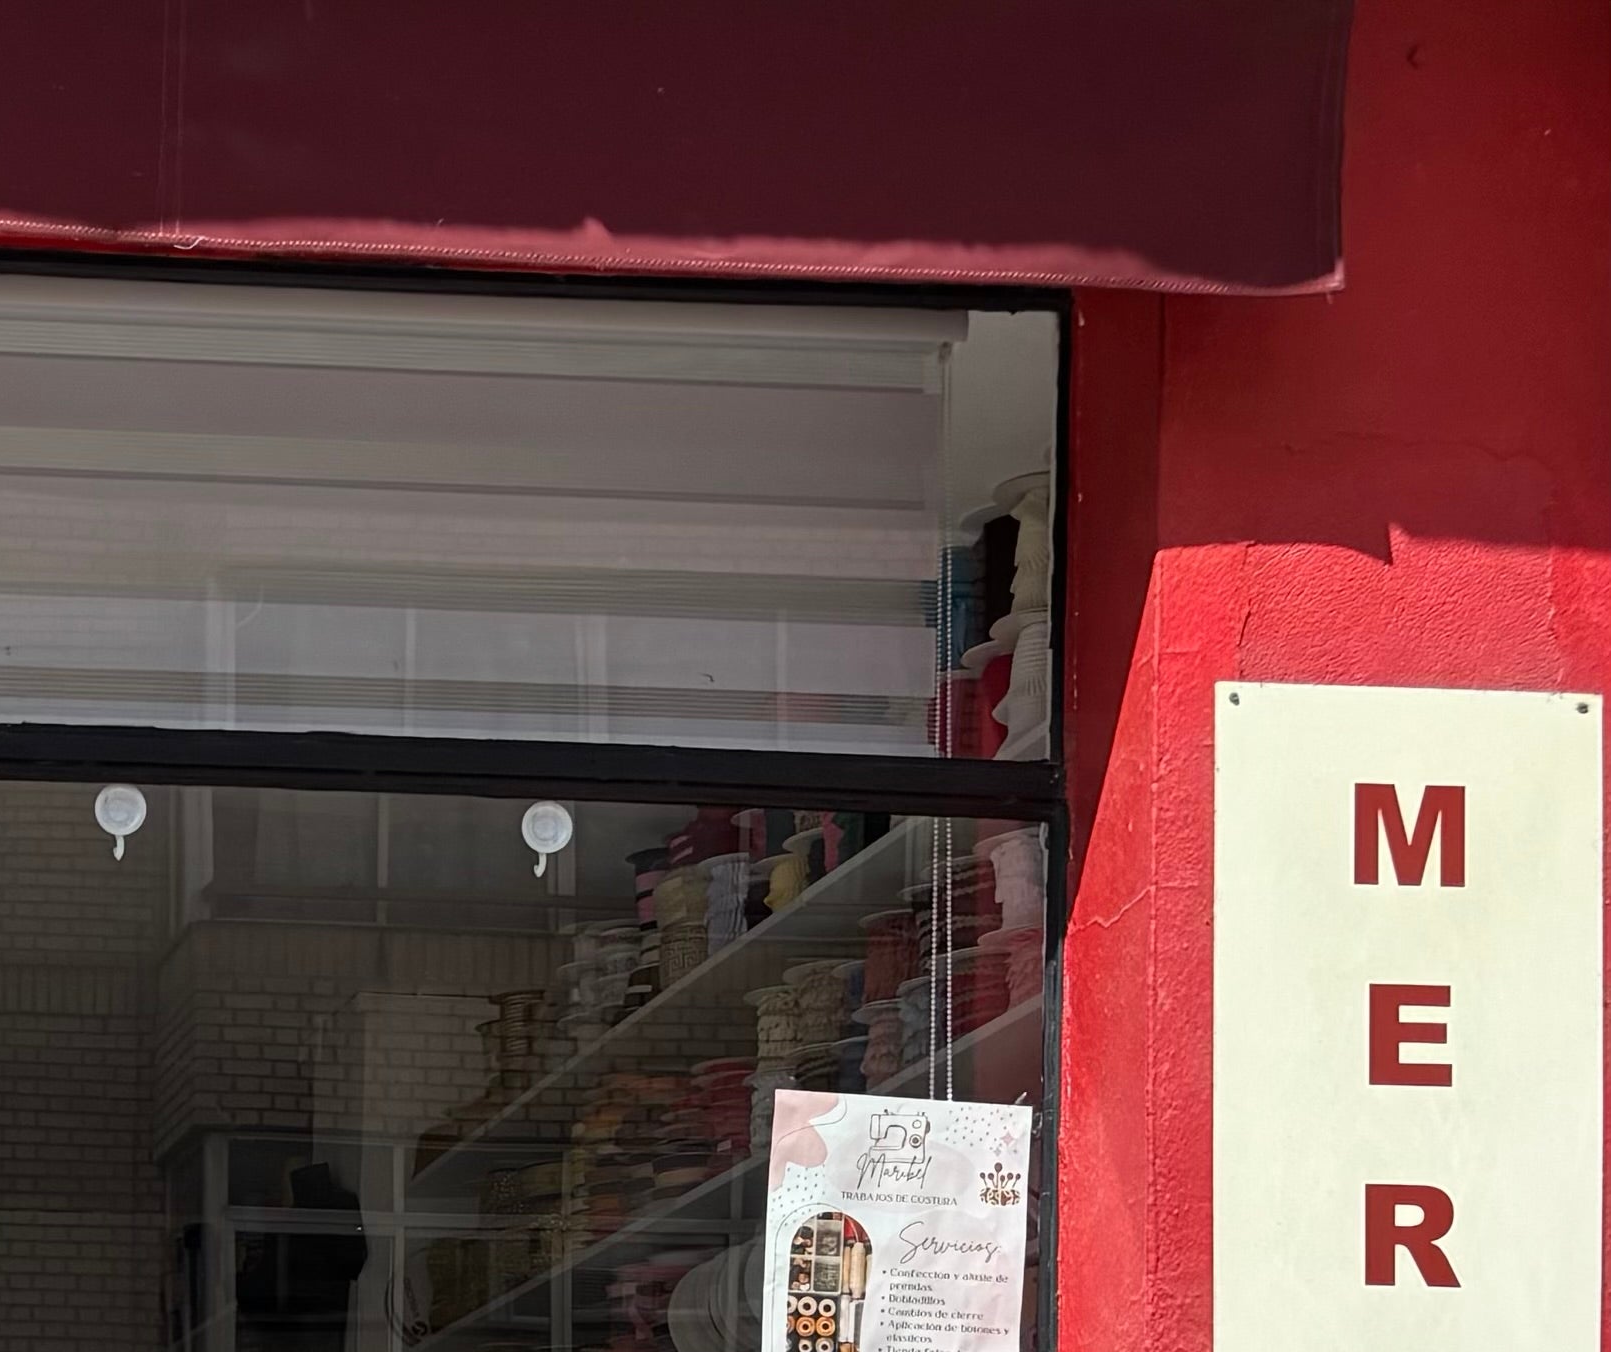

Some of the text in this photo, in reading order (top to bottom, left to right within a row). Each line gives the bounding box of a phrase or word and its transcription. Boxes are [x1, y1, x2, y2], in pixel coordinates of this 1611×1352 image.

[841, 1190, 958, 1206] TRABAJOS DE COSTURA
[995, 1274, 1009, 1284] de
[934, 1308, 949, 1318] de
[944, 1323, 958, 1333] de
